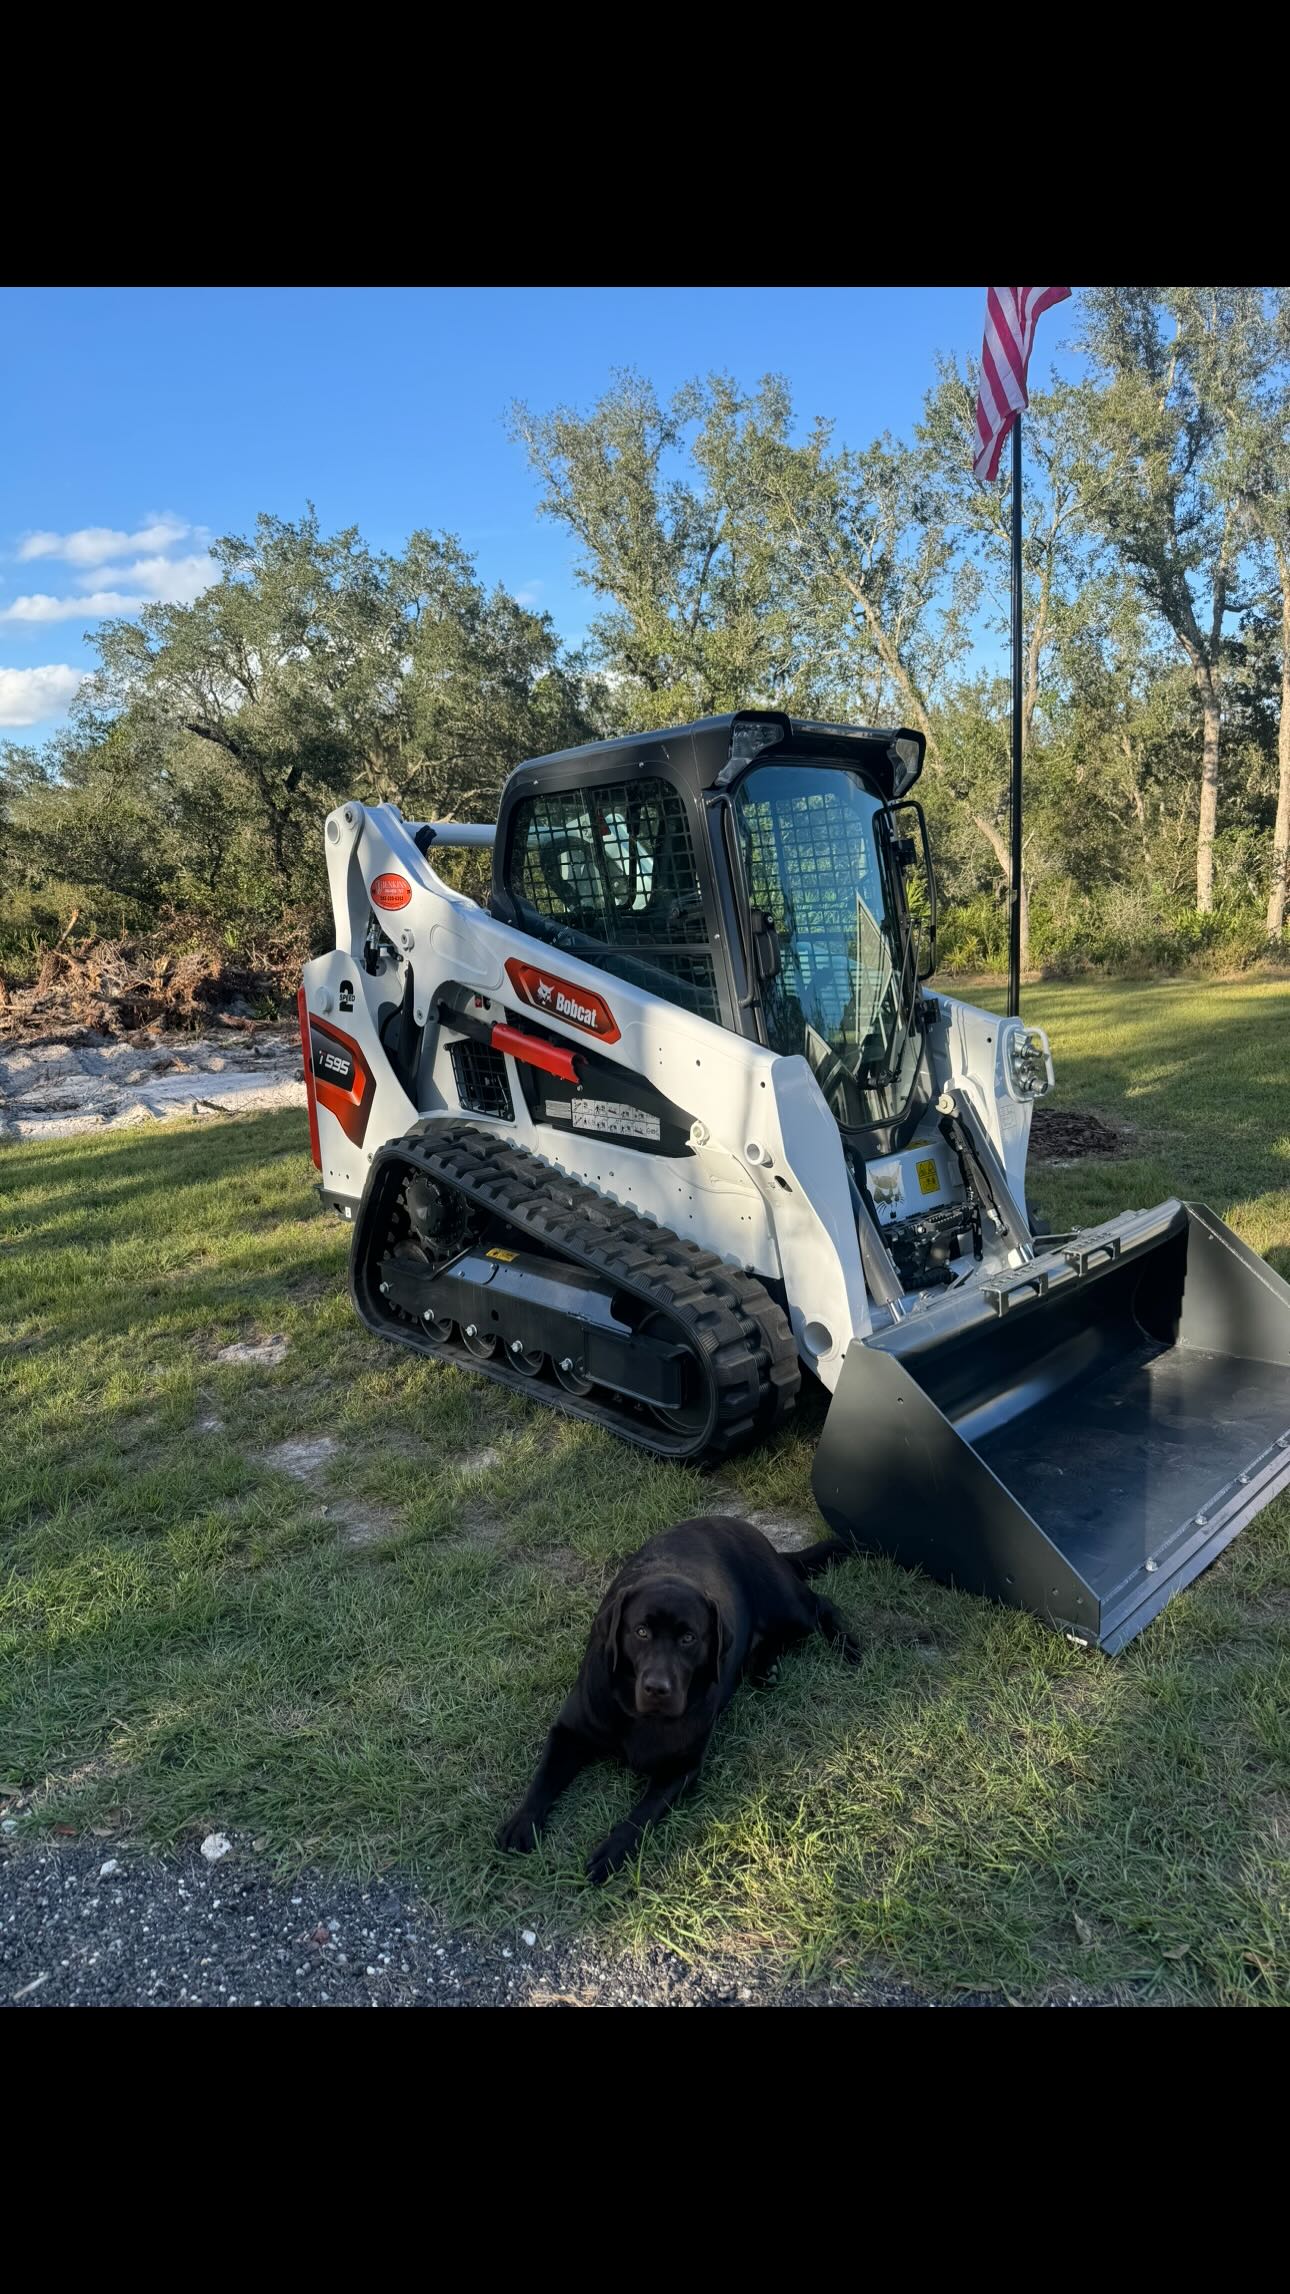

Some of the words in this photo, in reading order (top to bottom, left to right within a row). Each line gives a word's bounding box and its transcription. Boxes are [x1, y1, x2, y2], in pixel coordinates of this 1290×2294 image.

[339, 980, 354, 1012] 2
[340, 994, 355, 1002] SPEED
[556, 992, 597, 1027] Bobcat
